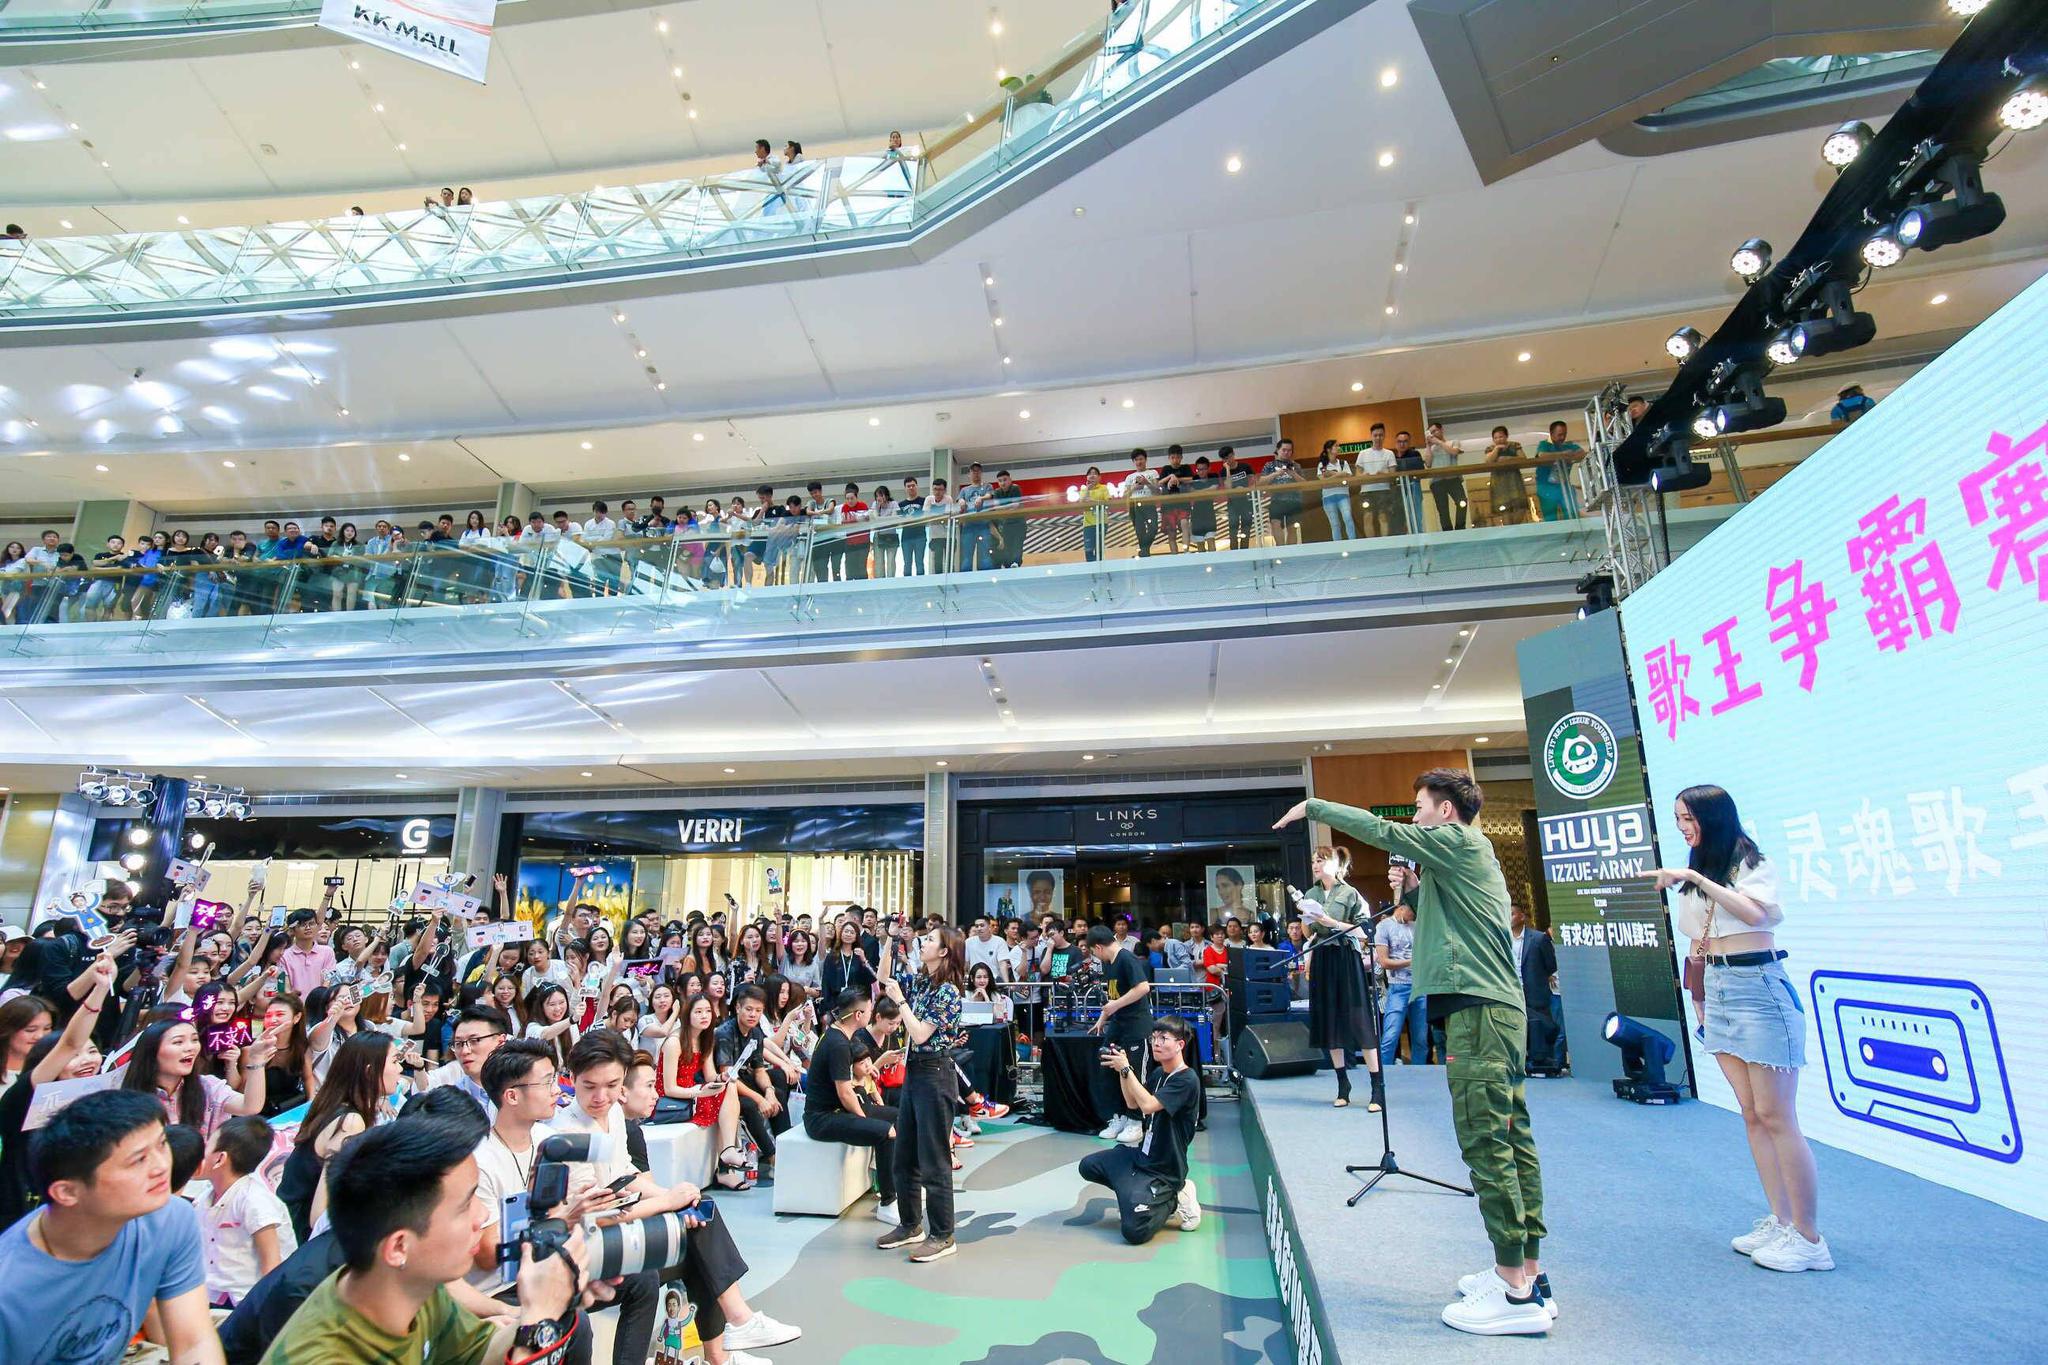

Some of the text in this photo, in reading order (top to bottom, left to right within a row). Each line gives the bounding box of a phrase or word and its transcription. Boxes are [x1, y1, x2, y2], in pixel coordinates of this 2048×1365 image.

[354, 4, 460, 57] KK MALL
[1553, 722, 1569, 740] REAL
[1590, 718, 1613, 759] YOURSELF
[1096, 809, 1158, 821] LINKS
[402, 818, 431, 849] G
[678, 818, 742, 844] VERRI
[1551, 858, 1644, 883] IZZUE-ARMY
[1560, 922, 1606, 947] 有求必应
[209, 1026, 253, 1051] 不求人
